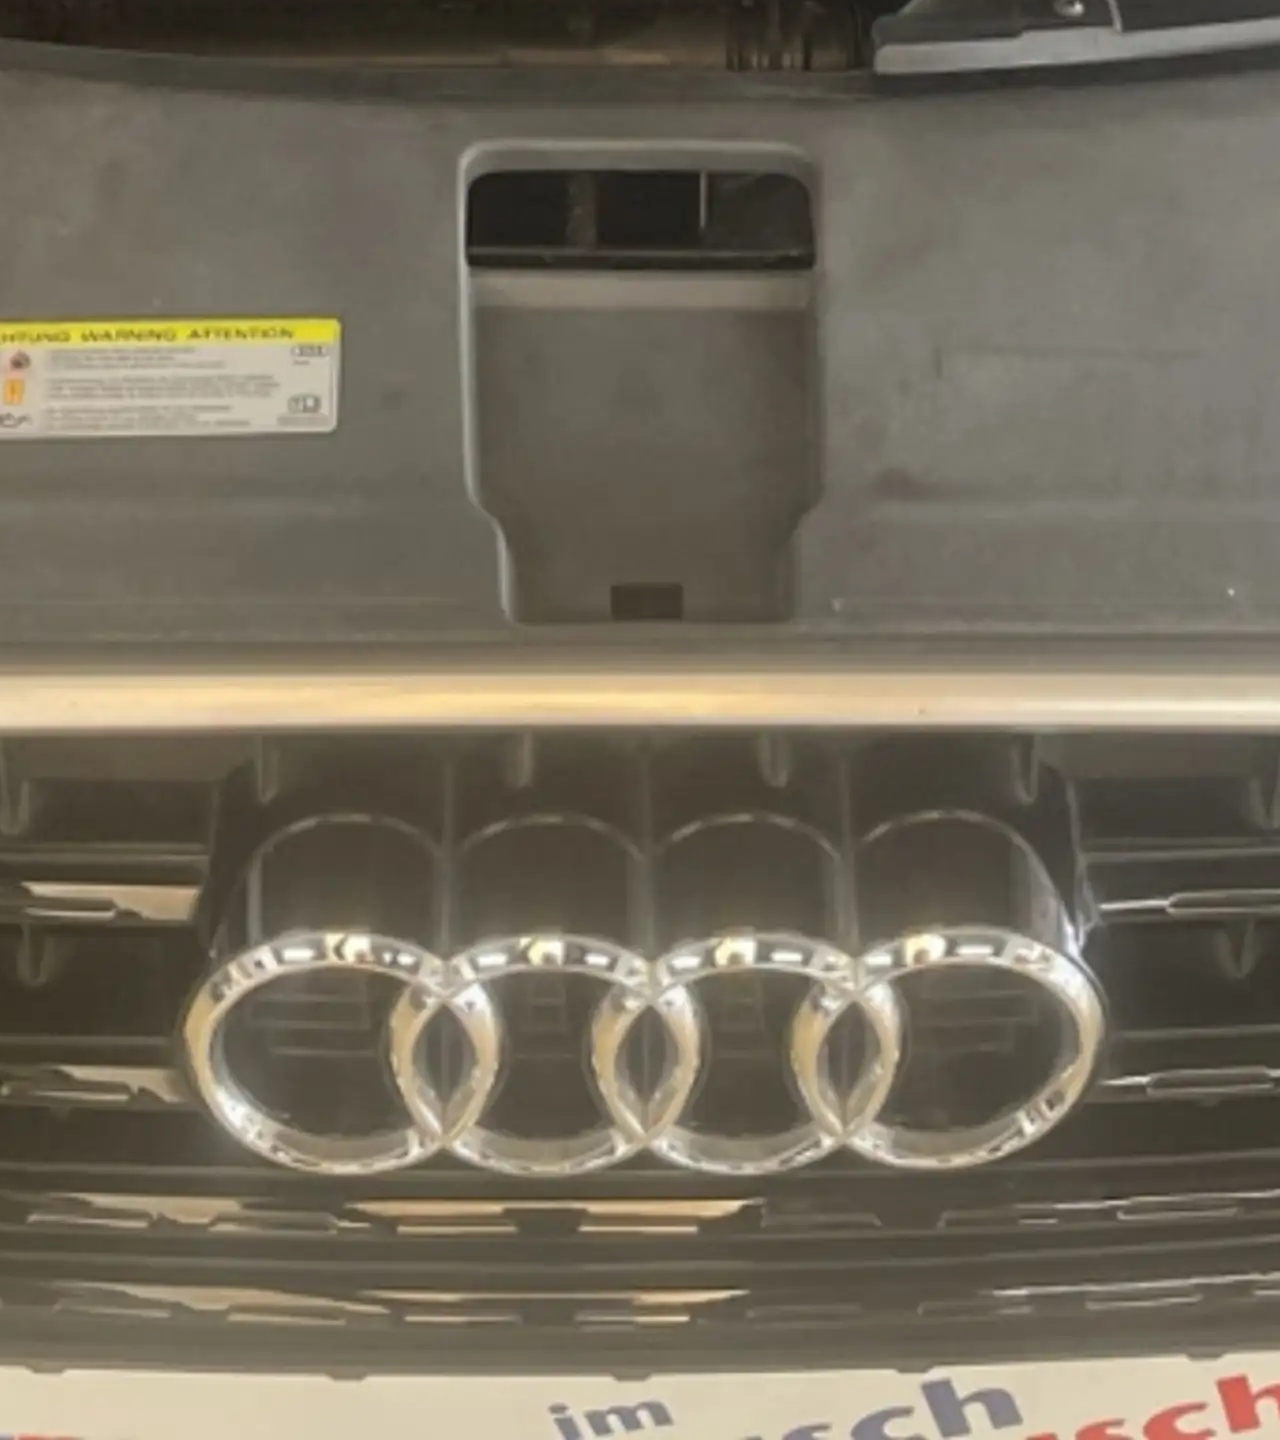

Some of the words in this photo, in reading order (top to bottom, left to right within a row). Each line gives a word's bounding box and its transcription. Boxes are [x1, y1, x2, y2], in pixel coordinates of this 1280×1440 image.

[81, 328, 177, 343] WARNING
[187, 326, 296, 341] ATTENTION
[548, 1398, 676, 1440] im
